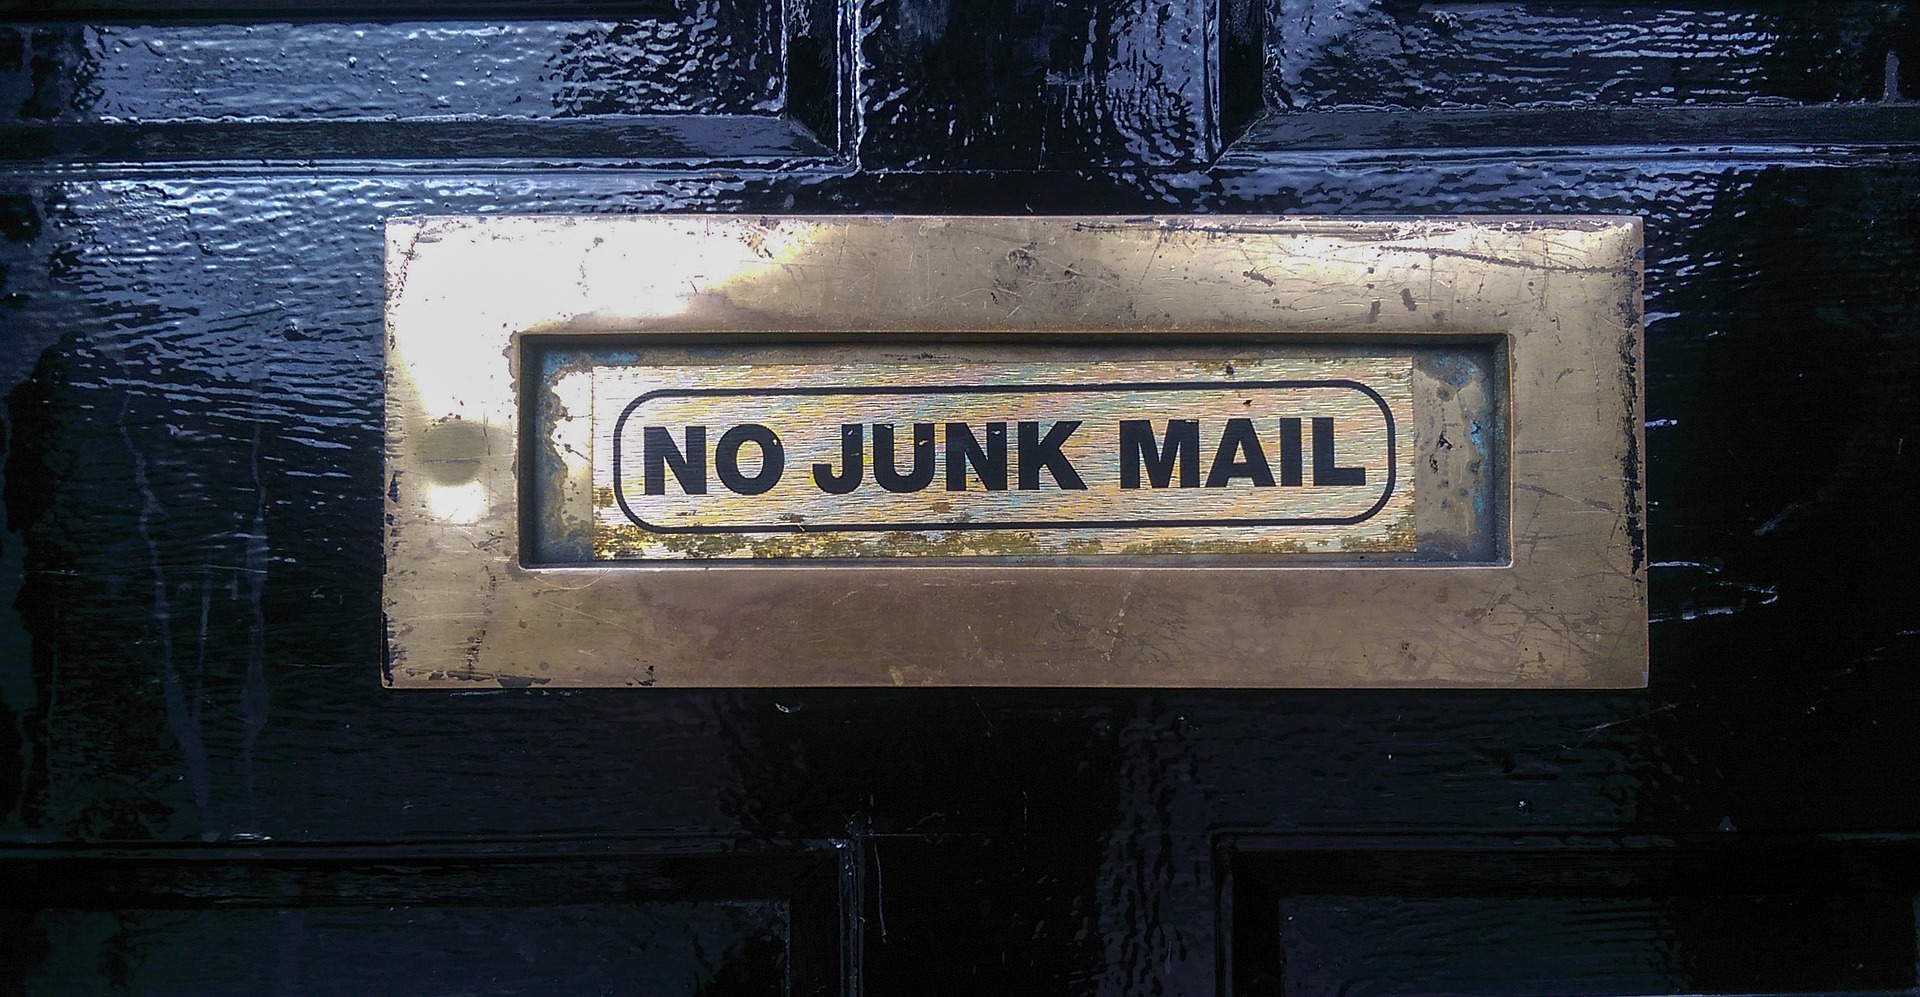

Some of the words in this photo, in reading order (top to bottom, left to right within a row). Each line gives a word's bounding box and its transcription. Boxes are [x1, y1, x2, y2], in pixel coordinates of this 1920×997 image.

[643, 424, 785, 496] NO
[812, 420, 1089, 495] JUNK
[1119, 417, 1367, 490] MAIL
